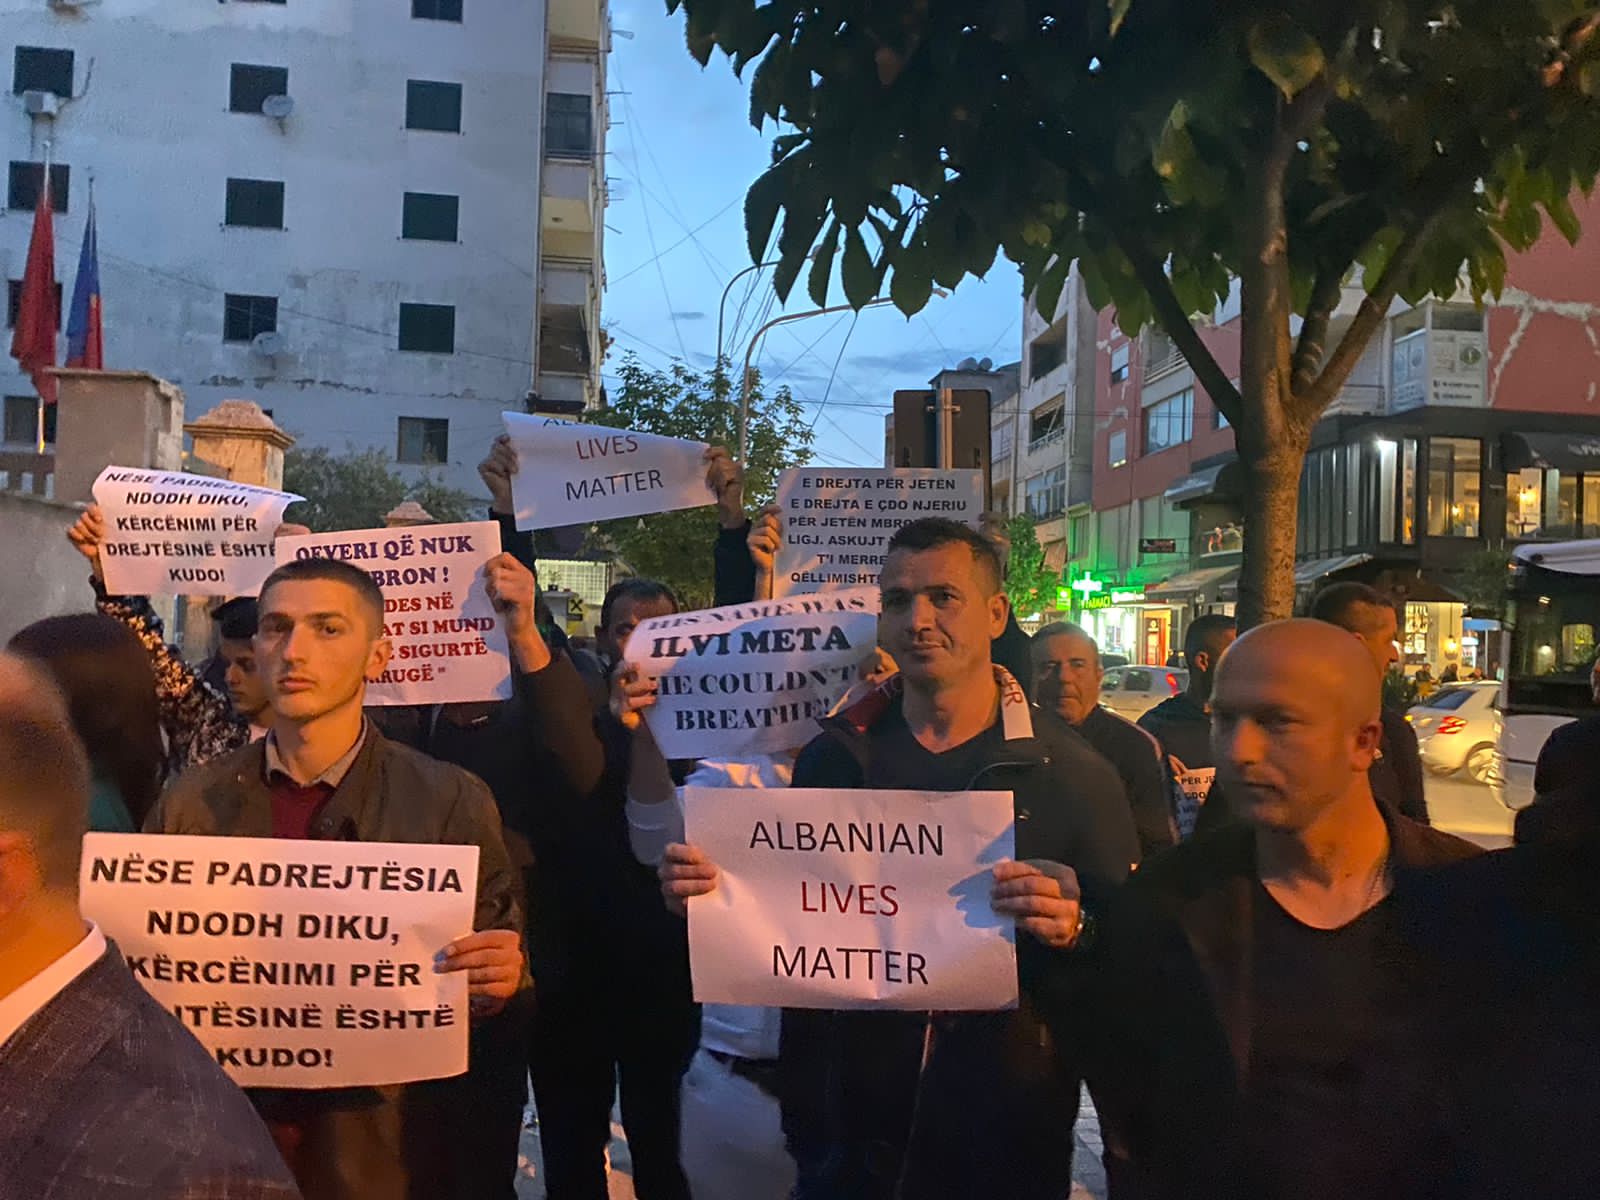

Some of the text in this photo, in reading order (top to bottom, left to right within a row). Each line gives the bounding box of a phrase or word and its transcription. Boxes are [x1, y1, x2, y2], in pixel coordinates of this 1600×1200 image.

[576, 435, 639, 460] LIVES
[566, 469, 664, 501] MATTER
[802, 478, 811, 488] E
[816, 478, 872, 489] DREJTA
[126, 491, 249, 508] NDODH DIKU,
[791, 498, 967, 512] E DREJTA E ÇDO NJERIU
[116, 513, 258, 532] KËRCËNIMI PËR
[871, 518, 915, 529] MBRO
[107, 540, 216, 556] DREJTËSINË
[383, 534, 415, 560] QË
[420, 535, 475, 555] NUK
[788, 534, 823, 545] LIGJ.
[828, 535, 886, 546] ASKUJT
[839, 554, 889, 565] MERRE
[169, 568, 225, 582] KUDO!
[371, 567, 436, 587] BRON
[791, 570, 881, 584] QËLLIMISHT
[384, 592, 454, 613] DES NË
[381, 618, 495, 637] AT SI MUND
[398, 637, 488, 660] SIGURTË
[650, 625, 852, 658] ILVI META
[749, 820, 944, 857] ALBANIAN
[91, 854, 463, 893] NËSE PADREJTËSIA
[801, 881, 899, 917] LIVES
[146, 910, 400, 945] NDODH DIKU,
[126, 954, 422, 987] KËRCËNIMI PËR
[772, 945, 929, 985] MATTER
[336, 1002, 455, 1029] ËSHTË
[215, 1048, 333, 1068] KUDO!
